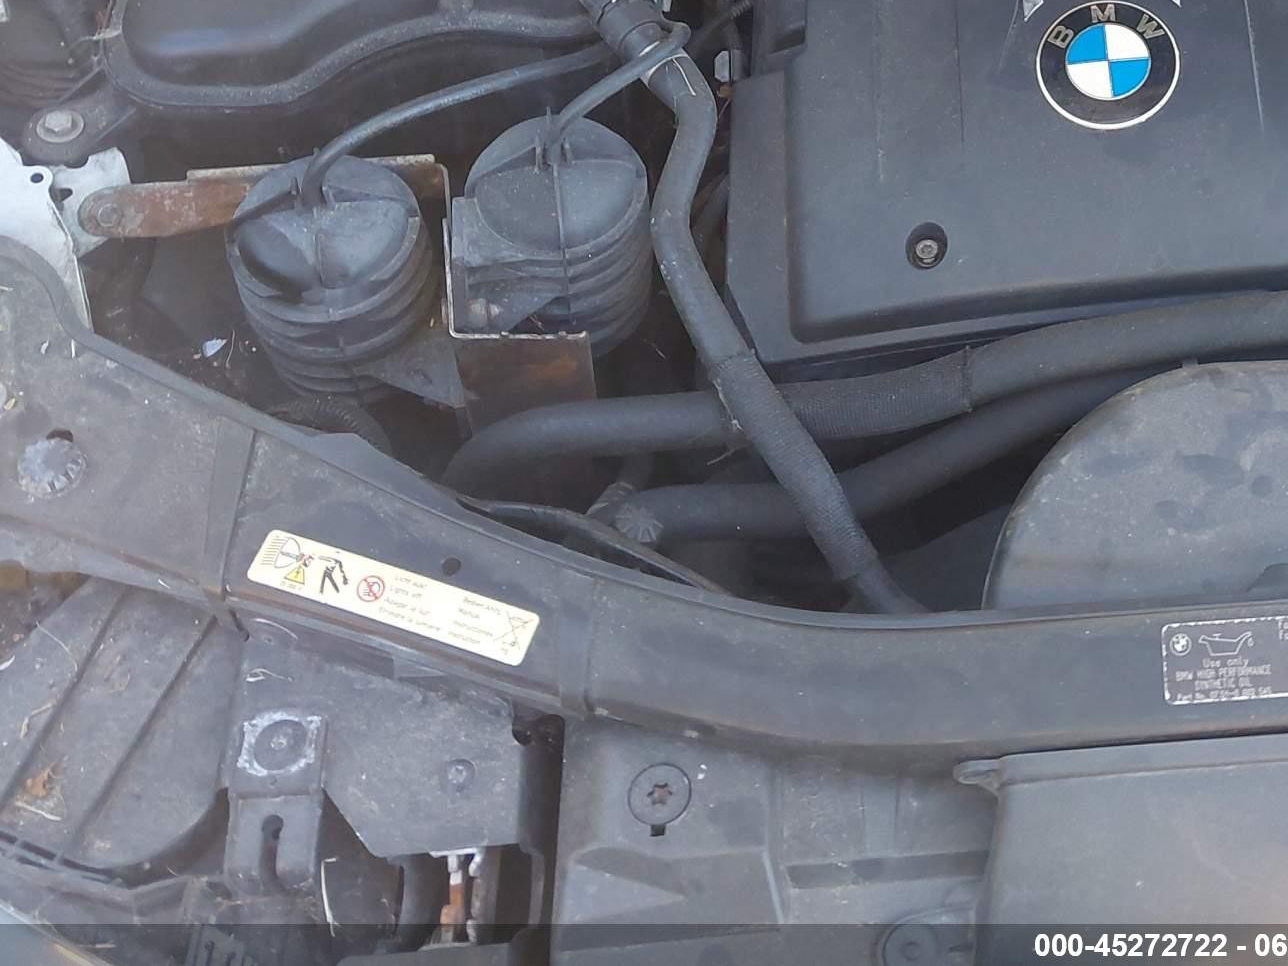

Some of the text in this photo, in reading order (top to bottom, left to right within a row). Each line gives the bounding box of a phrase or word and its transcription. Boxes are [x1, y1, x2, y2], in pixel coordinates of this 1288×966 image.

[1047, 3, 1166, 50] BMW
[1203, 656, 1248, 669] Use only
